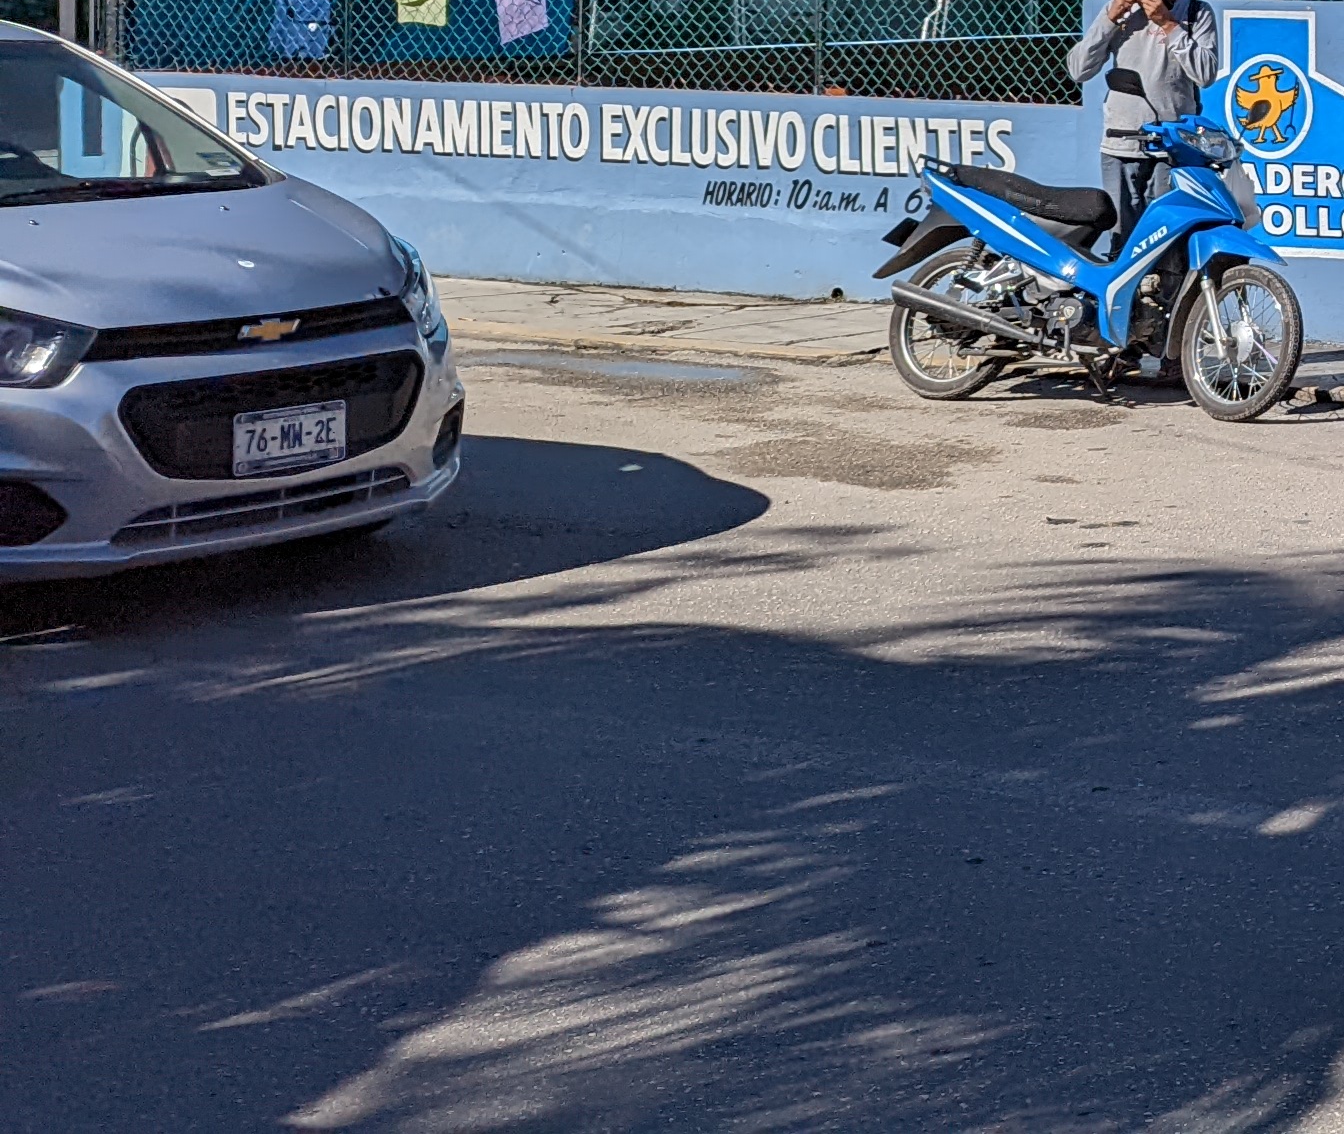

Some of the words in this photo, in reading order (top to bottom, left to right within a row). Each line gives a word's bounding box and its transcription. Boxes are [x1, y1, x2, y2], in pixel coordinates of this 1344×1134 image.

[226, 91, 591, 162] ESTACIONAMIENTO
[600, 102, 806, 171] EXCLUSIVO
[811, 112, 1017, 177] CLIENTES
[702, 180, 781, 207] HORARIO:
[874, 186, 890, 213] A
